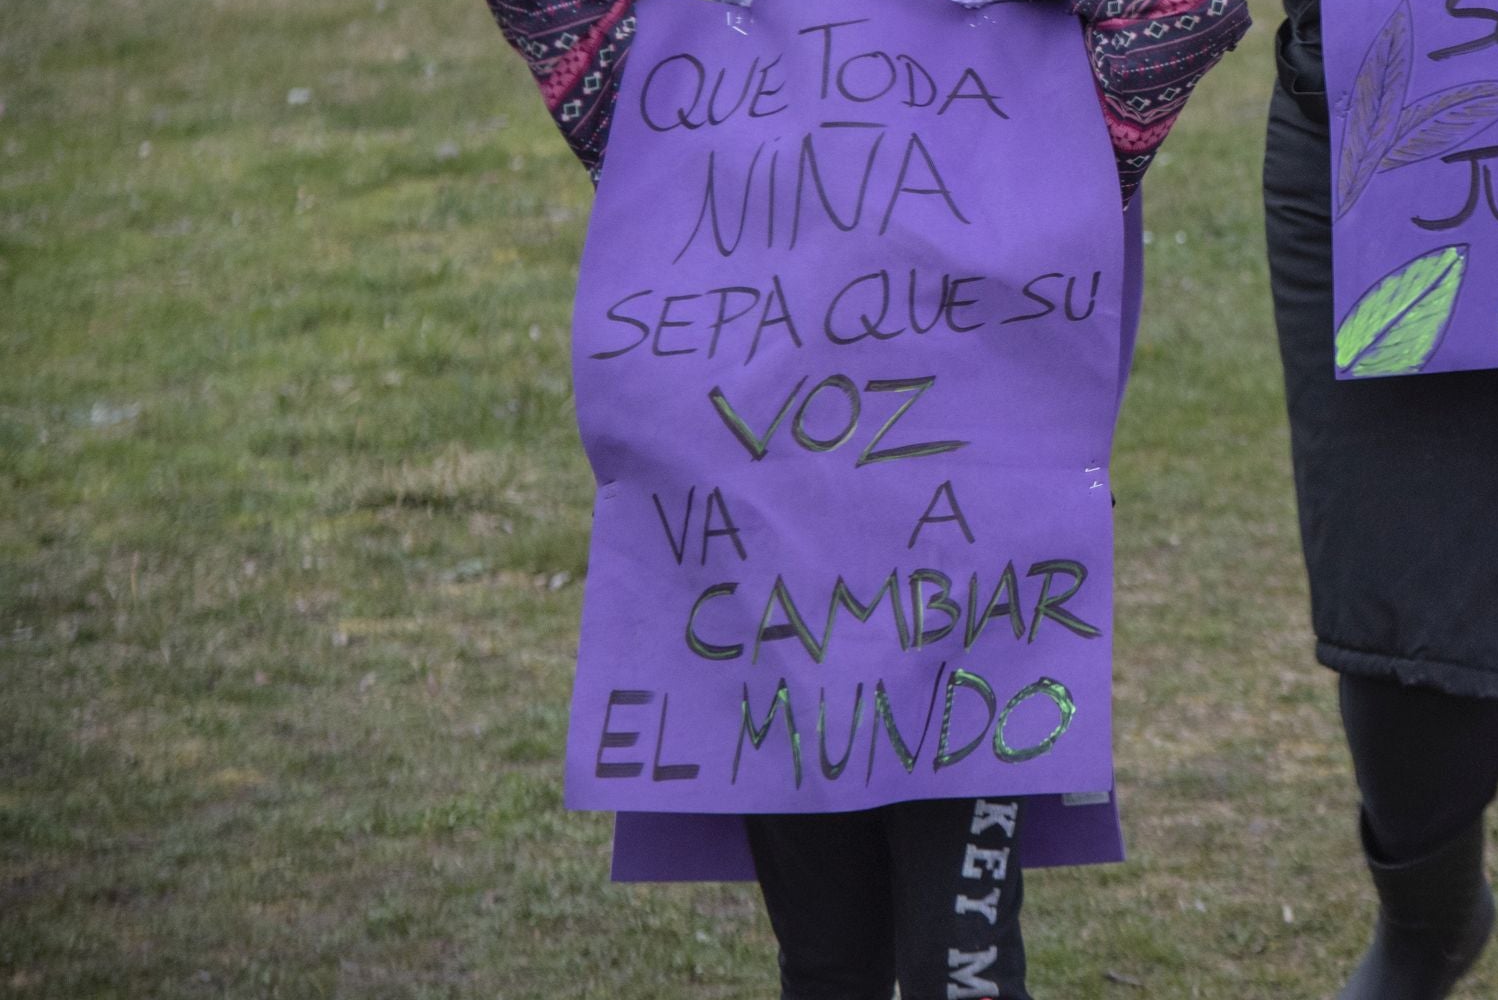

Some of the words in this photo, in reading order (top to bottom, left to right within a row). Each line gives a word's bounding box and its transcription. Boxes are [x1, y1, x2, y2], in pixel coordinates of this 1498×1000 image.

[640, 52, 789, 133] QUE
[798, 18, 1010, 121] TODA
[588, 274, 804, 366] SEPA
[823, 269, 987, 346] QUE
[1000, 270, 1102, 326] SU
[708, 374, 972, 469] VOZ
[652, 485, 748, 567] VA
[907, 479, 977, 550] A
[684, 559, 1103, 665] CAMBIAR
[594, 689, 701, 783] EL
[731, 660, 1078, 791] MUNDO
